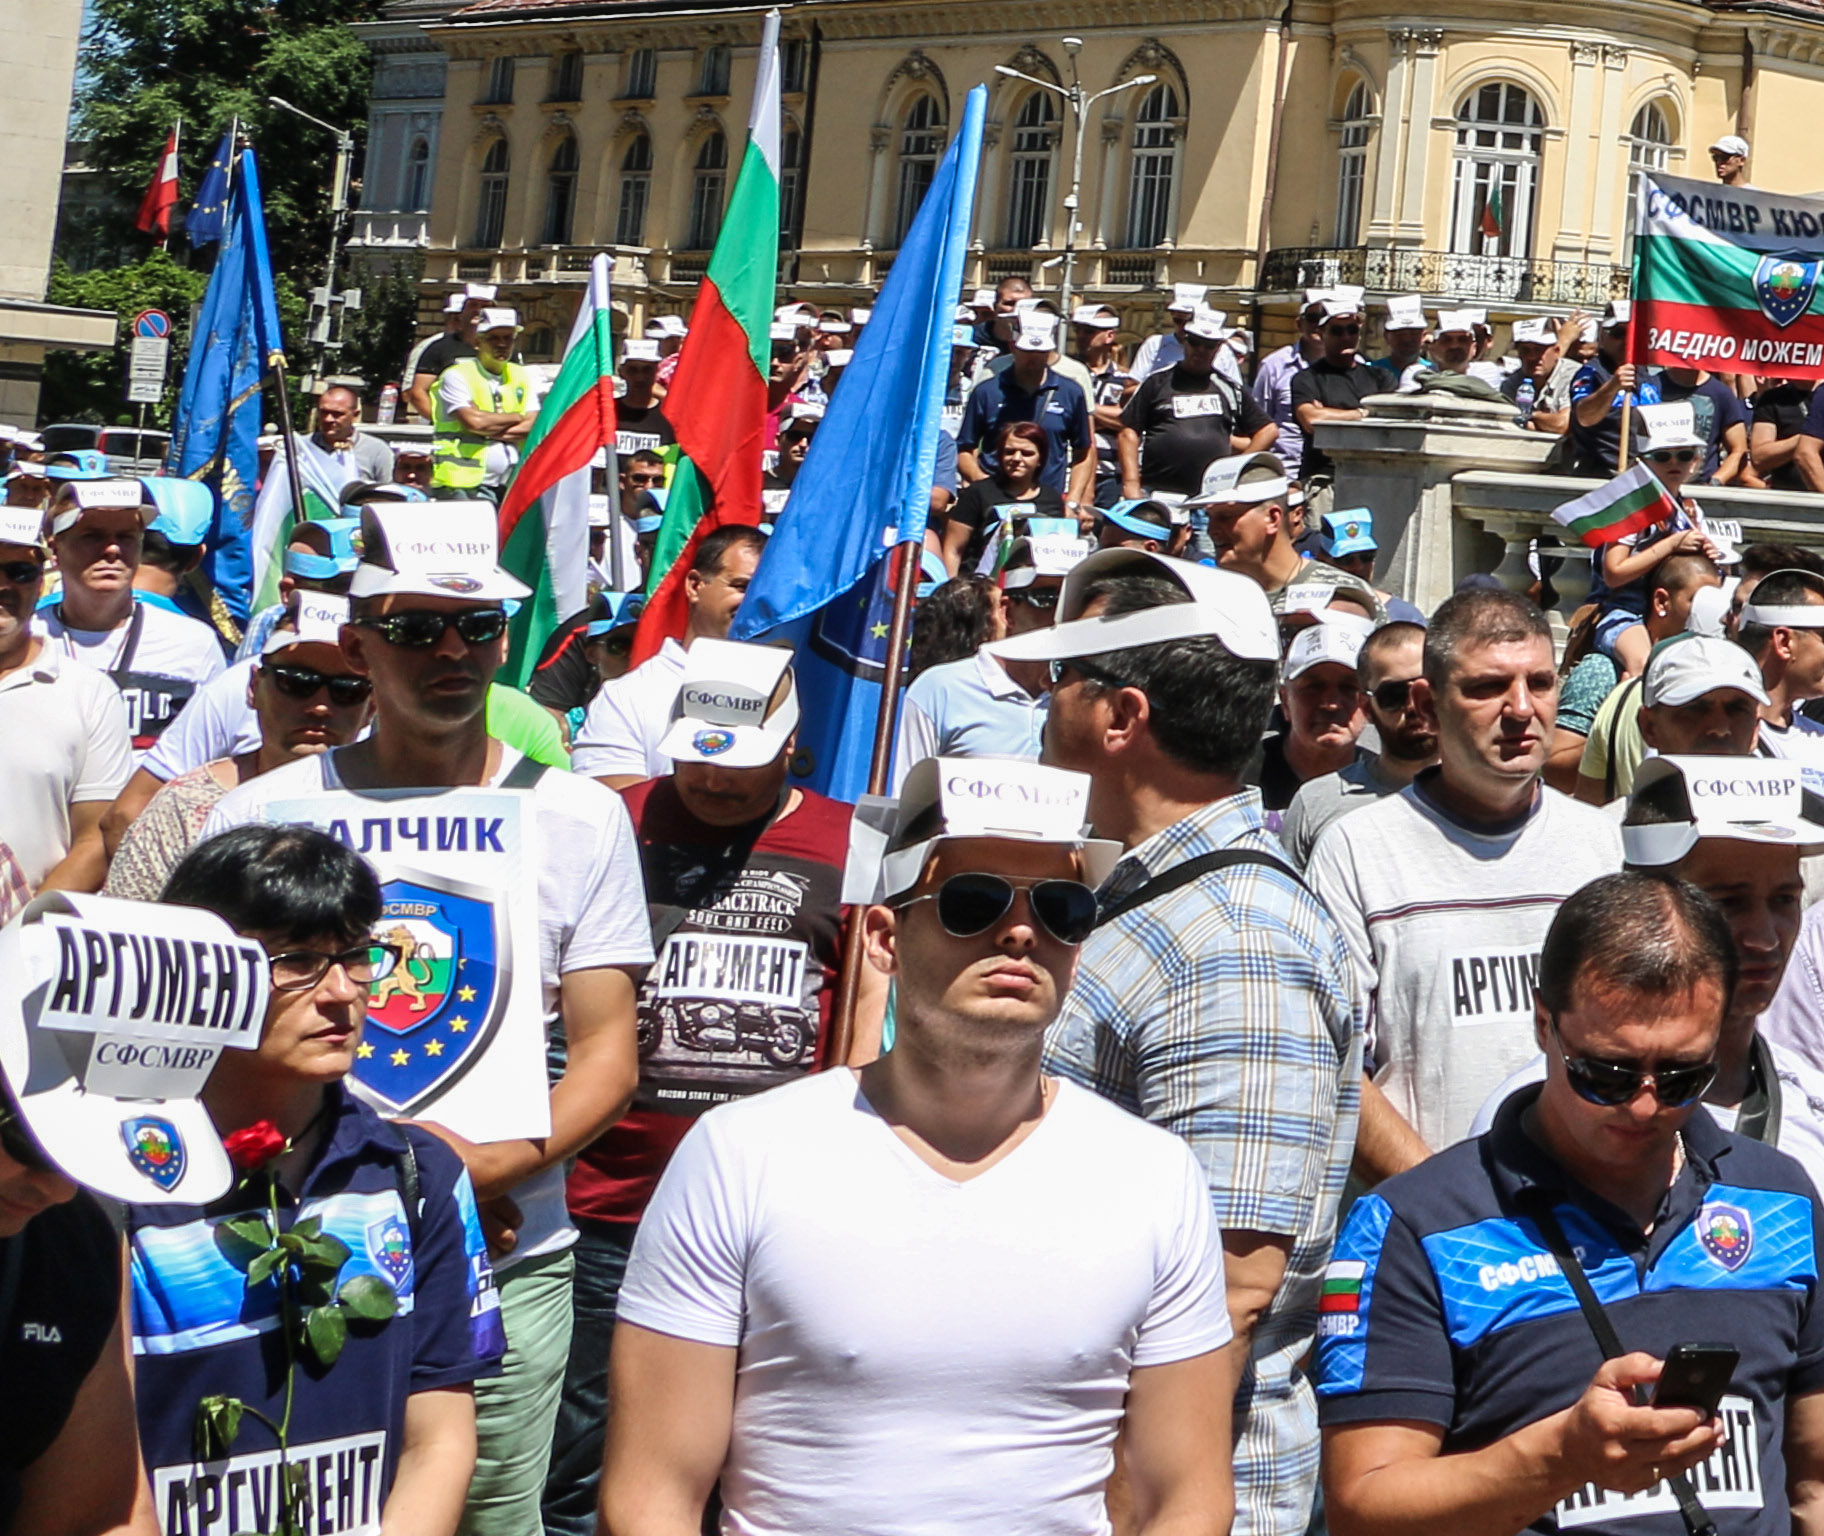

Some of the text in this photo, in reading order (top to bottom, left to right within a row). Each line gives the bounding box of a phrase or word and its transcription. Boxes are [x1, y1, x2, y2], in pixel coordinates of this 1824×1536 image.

[1649, 188, 1761, 235] СФСМВР
[1648, 327, 1737, 360] ЗАЕДНО
[1740, 338, 1823, 367] МОЖЕМ
[395, 542, 491, 556] СФСМВР
[685, 690, 763, 712] СФСМВР
[1693, 777, 1796, 798] СФСМВР
[286, 816, 506, 854] АЛЧИК
[689, 910, 785, 932] SOUL AND FEEL
[50, 926, 262, 1032] АРГУМЕНТ
[664, 941, 804, 998] АРГУМЕНТ
[96, 1041, 214, 1070] СФСМВР
[1478, 1245, 1588, 1293] СФСМР
[23, 1322, 61, 1342] FILA
